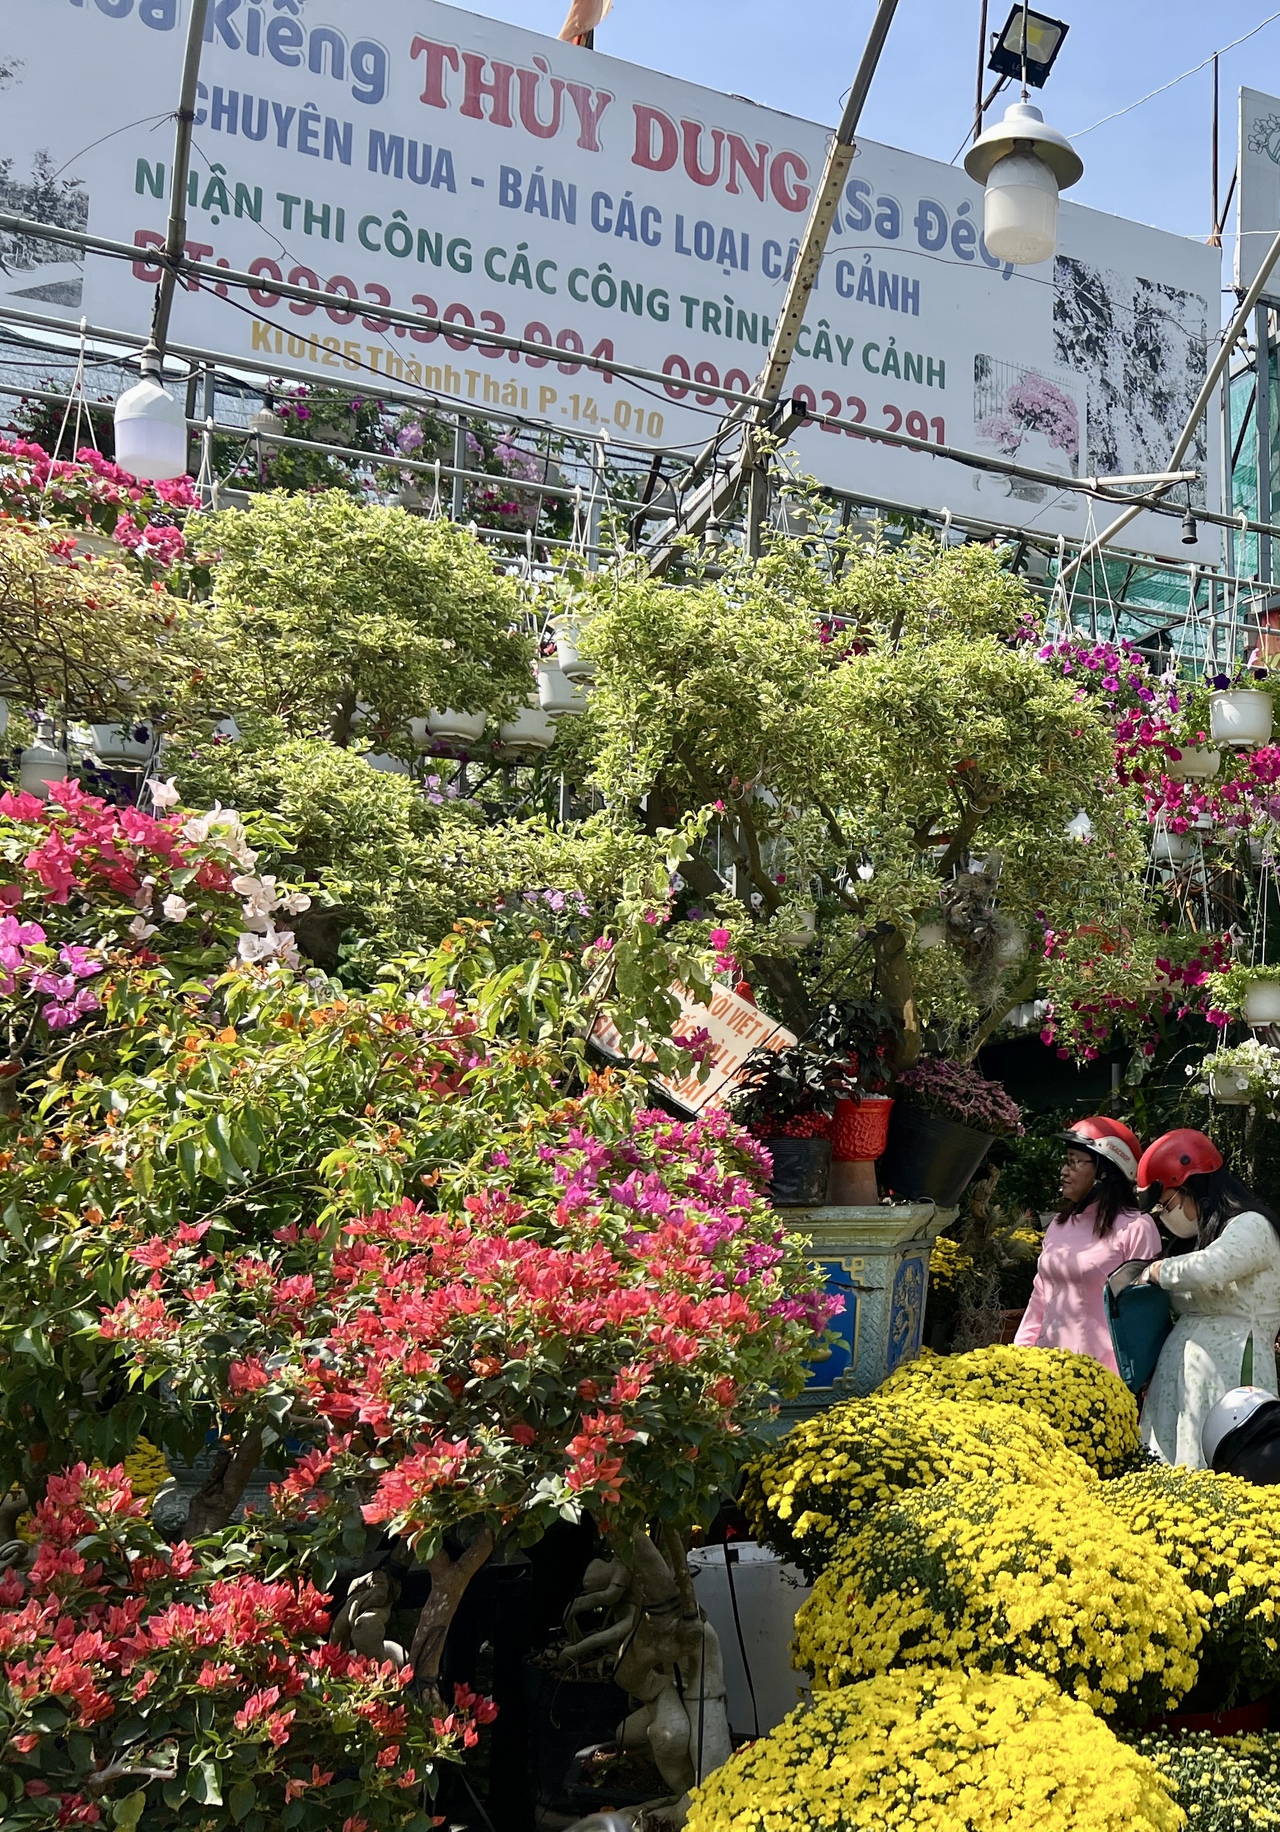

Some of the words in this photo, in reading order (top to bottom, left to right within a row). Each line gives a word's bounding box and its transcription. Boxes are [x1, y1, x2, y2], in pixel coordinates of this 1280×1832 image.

[194, 80, 353, 166] CHUYÊN
[368, 128, 457, 193] MUA
[499, 165, 577, 226] BÁN
[590, 190, 662, 247] CÁC
[674, 214, 750, 276] LOẠI
[835, 253, 920, 316] CẢNH
[410, 35, 612, 152] THÙY
[631, 103, 811, 212] DUNG
[135, 158, 263, 225] NHẬN
[276, 192, 345, 243] THI
[358, 209, 472, 274] CÔNG
[484, 241, 557, 295] CÁC
[567, 262, 669, 322] CÔNG
[680, 294, 777, 347] TRÌNH
[795, 319, 853, 366] CÂY
[862, 336, 945, 389] CẢNH
[247, 257, 614, 384] 0903.303.994
[464, 368, 528, 410] Thái
[726, 1007, 763, 1040] VIỆT
